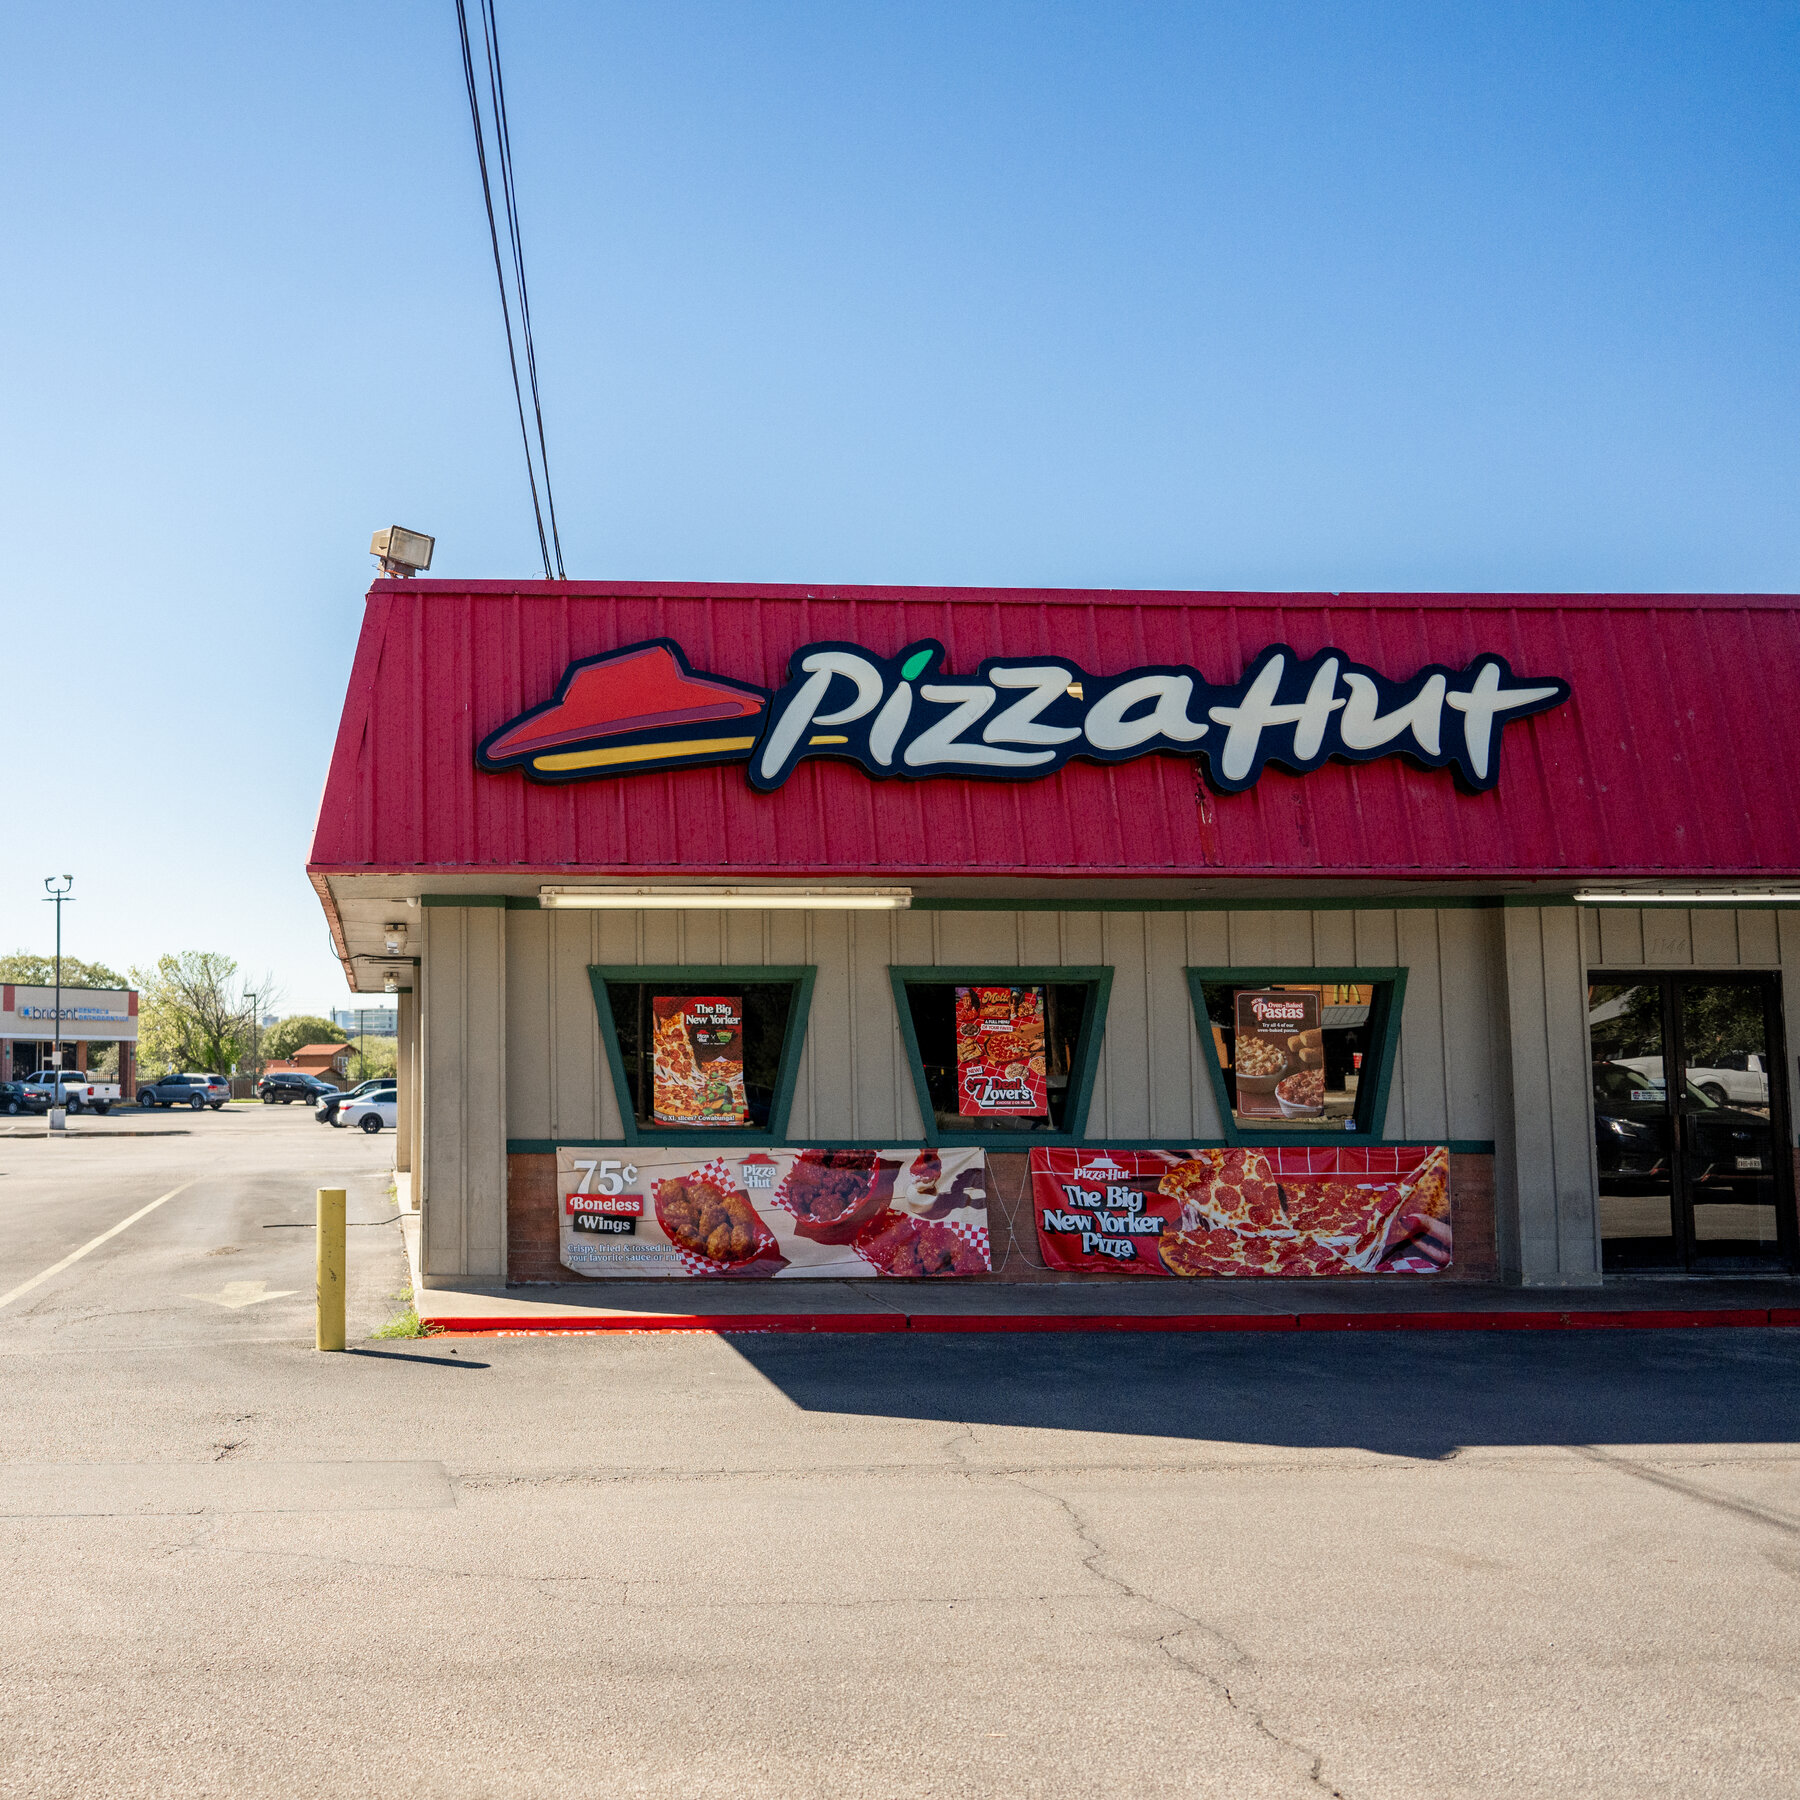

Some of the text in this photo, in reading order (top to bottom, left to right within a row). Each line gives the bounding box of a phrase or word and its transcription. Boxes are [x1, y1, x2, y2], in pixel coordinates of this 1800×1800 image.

[761, 650, 1559, 780] Pizza Hut
[32, 1006, 78, 1020] brident
[694, 1004, 732, 1016] The Big
[1252, 1002, 1304, 1021] Pastas
[686, 1014, 740, 1024] New Yorker
[966, 1077, 1021, 1099] $7 Deal
[743, 1164, 776, 1178] Pizza
[1074, 1168, 1131, 1180] Pizza Hut
[744, 1176, 770, 1188] Hut
[570, 1197, 640, 1211] Boneless
[1062, 1185, 1143, 1212] The Big
[578, 1215, 631, 1233] Wings
[1043, 1209, 1164, 1233] New Yorker
[600, 1244, 620, 1252] fried
[632, 1244, 660, 1252] tossed
[1082, 1232, 1135, 1257] Pizza
[568, 1254, 588, 1262] your
[590, 1254, 624, 1262] favorite
